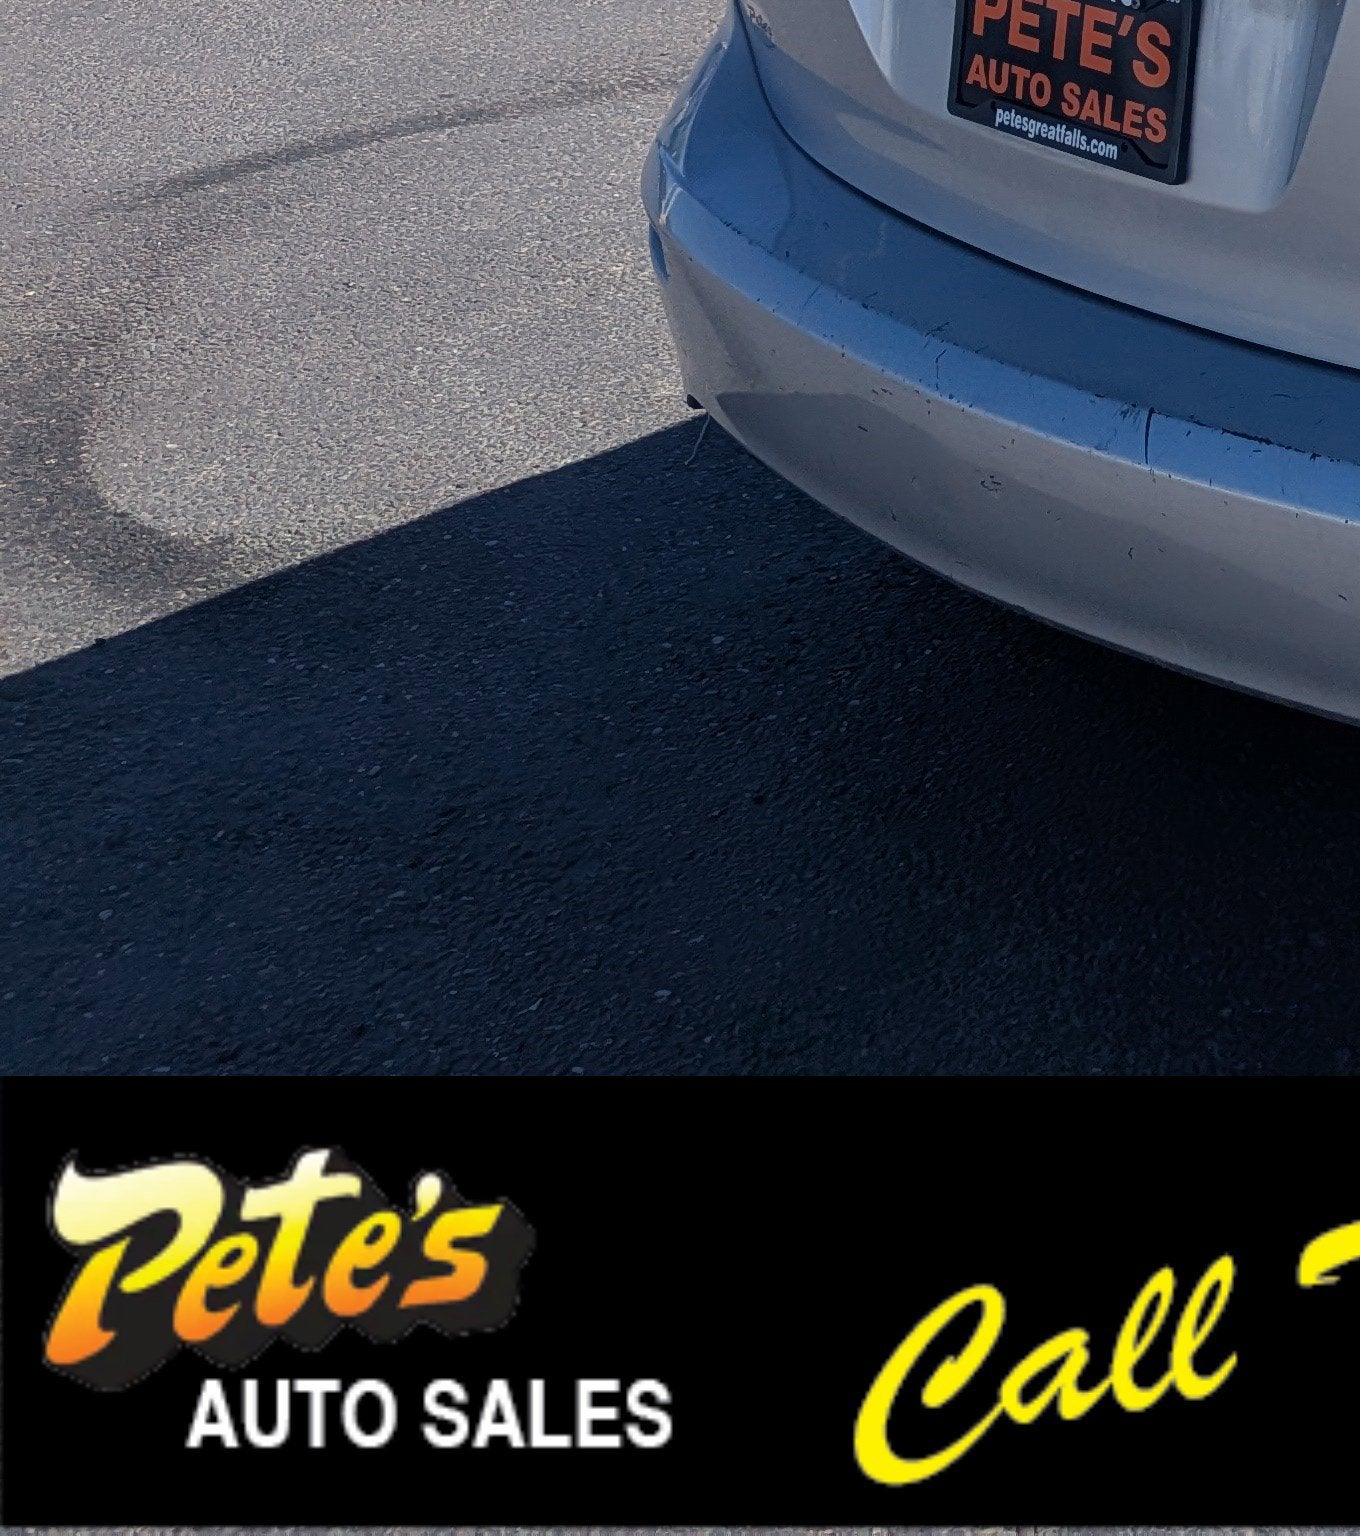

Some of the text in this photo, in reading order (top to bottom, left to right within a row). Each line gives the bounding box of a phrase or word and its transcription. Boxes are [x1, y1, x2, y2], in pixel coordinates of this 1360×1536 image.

[965, 53, 1167, 144] AUTO SALES
[995, 107, 1118, 160] petesgreatfalls.com
